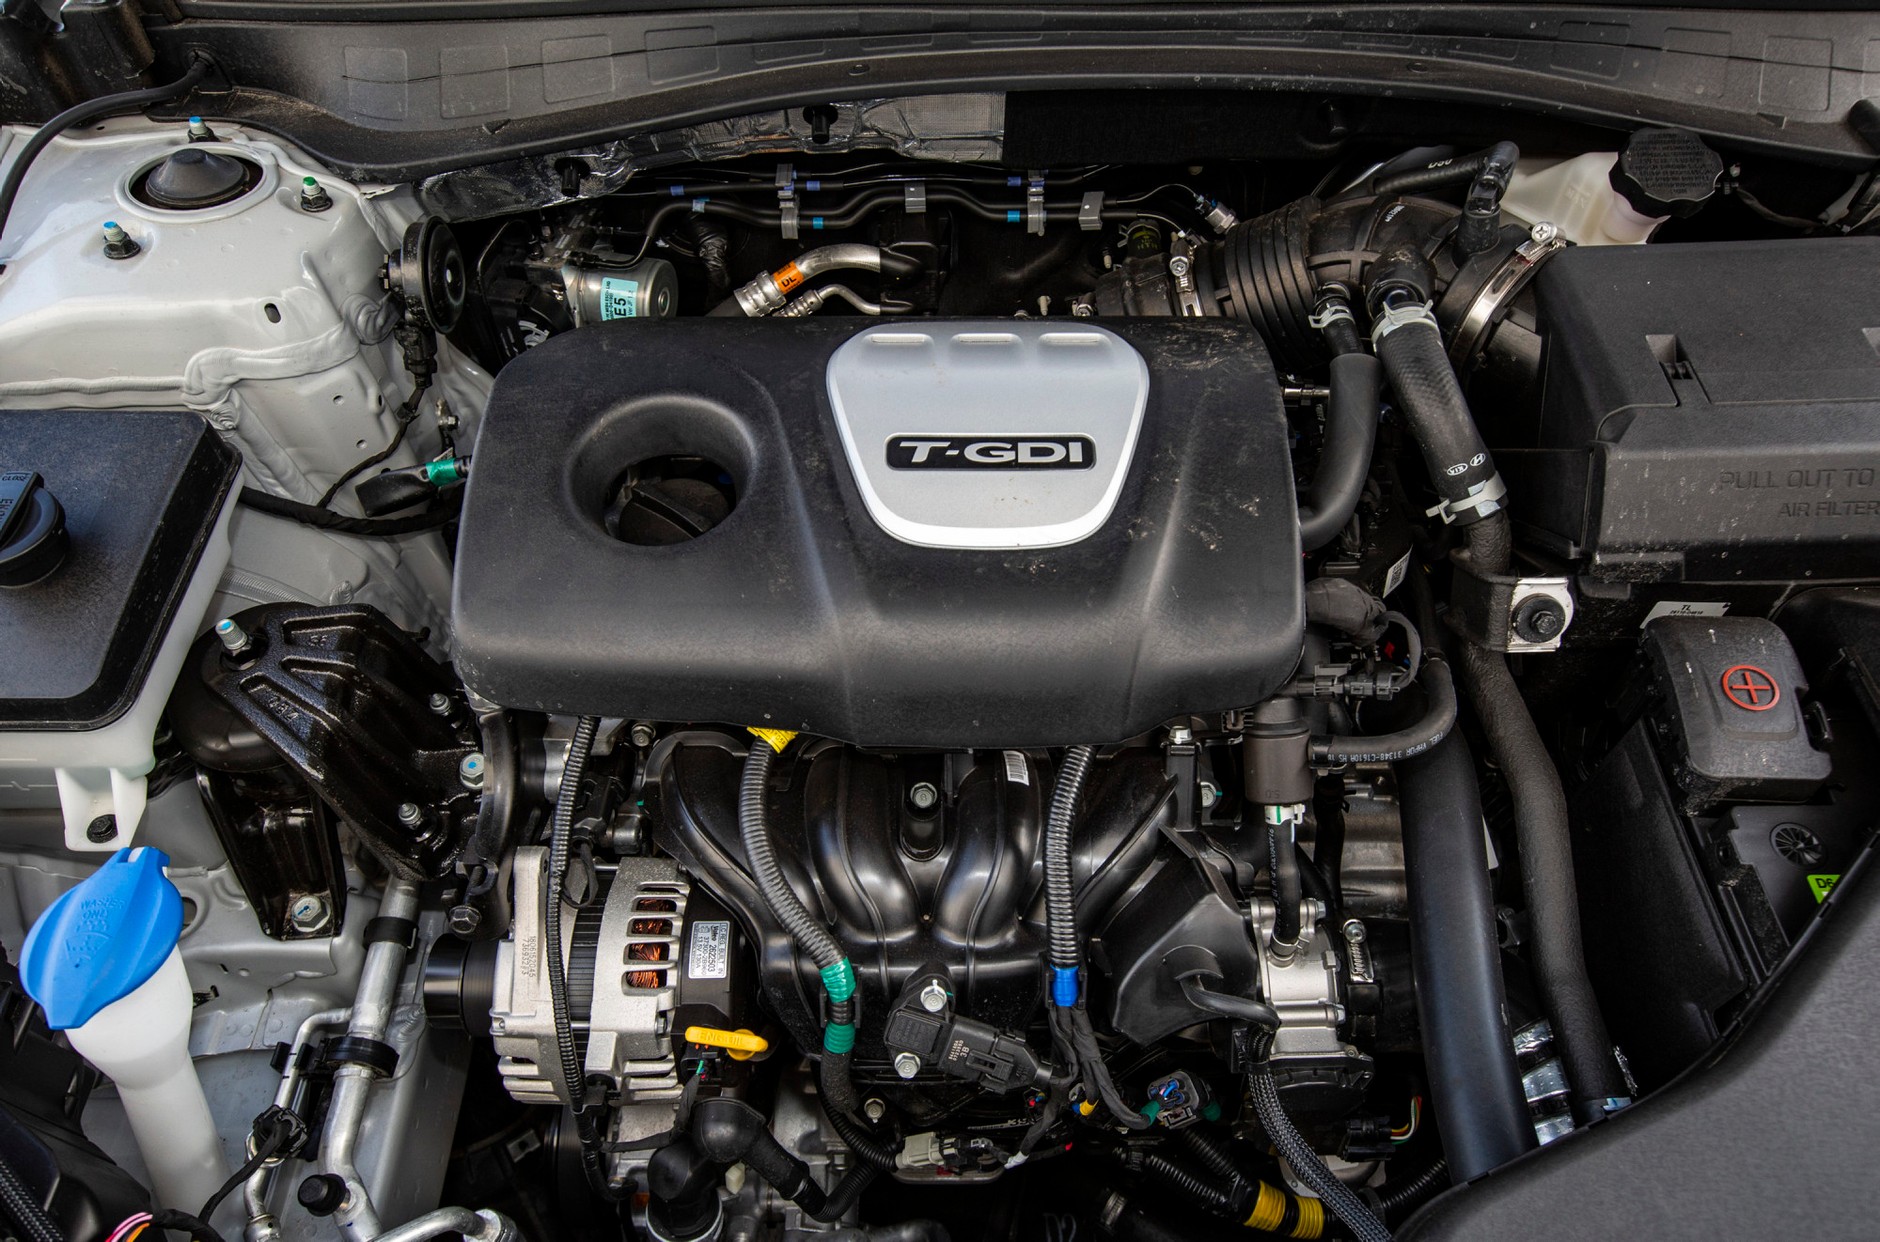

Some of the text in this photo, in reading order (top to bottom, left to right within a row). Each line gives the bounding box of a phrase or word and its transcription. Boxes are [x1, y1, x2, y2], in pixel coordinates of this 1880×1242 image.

[781, 276, 797, 288] DL
[613, 297, 627, 316] E5
[899, 441, 1083, 463] T-GDI
[1448, 464, 1466, 475] KIA
[1720, 468, 1876, 489] PULL OUT TO
[1778, 500, 1880, 517] AIR FILTER
[1428, 731, 1443, 745] FUEL
[1406, 741, 1427, 756] VAPOR
[958, 1043, 970, 1059] 3B
